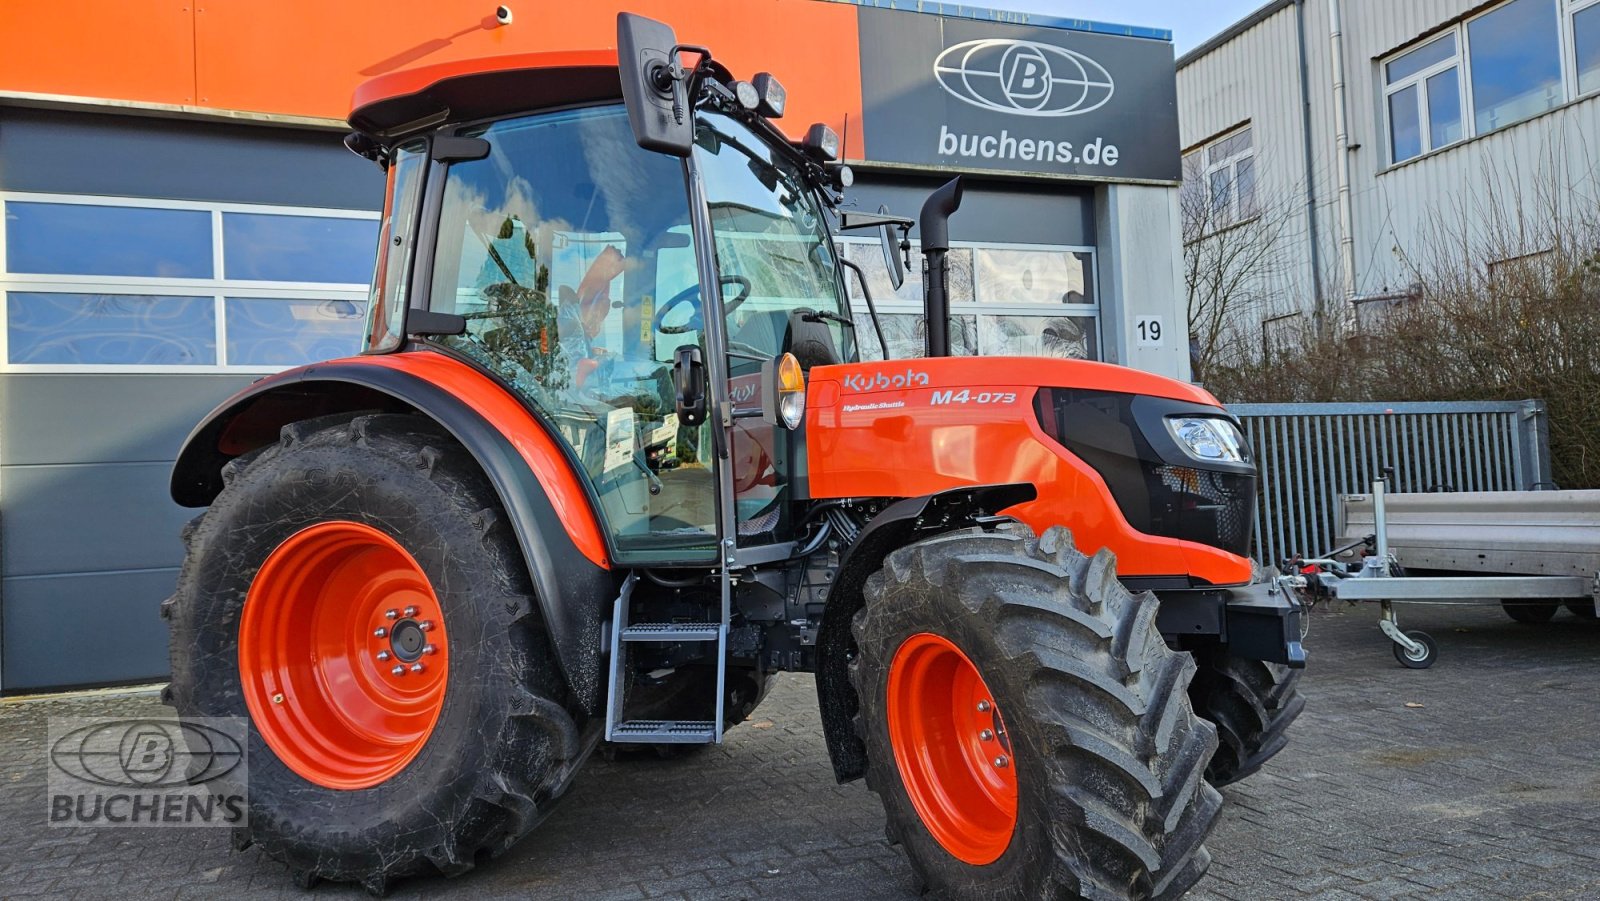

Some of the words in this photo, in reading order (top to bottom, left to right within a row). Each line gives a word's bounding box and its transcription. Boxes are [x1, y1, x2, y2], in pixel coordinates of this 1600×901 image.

[1008, 54, 1049, 99] B
[938, 125, 1119, 166] buchens.de
[1138, 320, 1161, 341] 19
[844, 369, 930, 392] Kubota
[842, 404, 878, 412] Hydraulic
[878, 401, 905, 409] Shuttle
[930, 389, 1017, 405] M4-073
